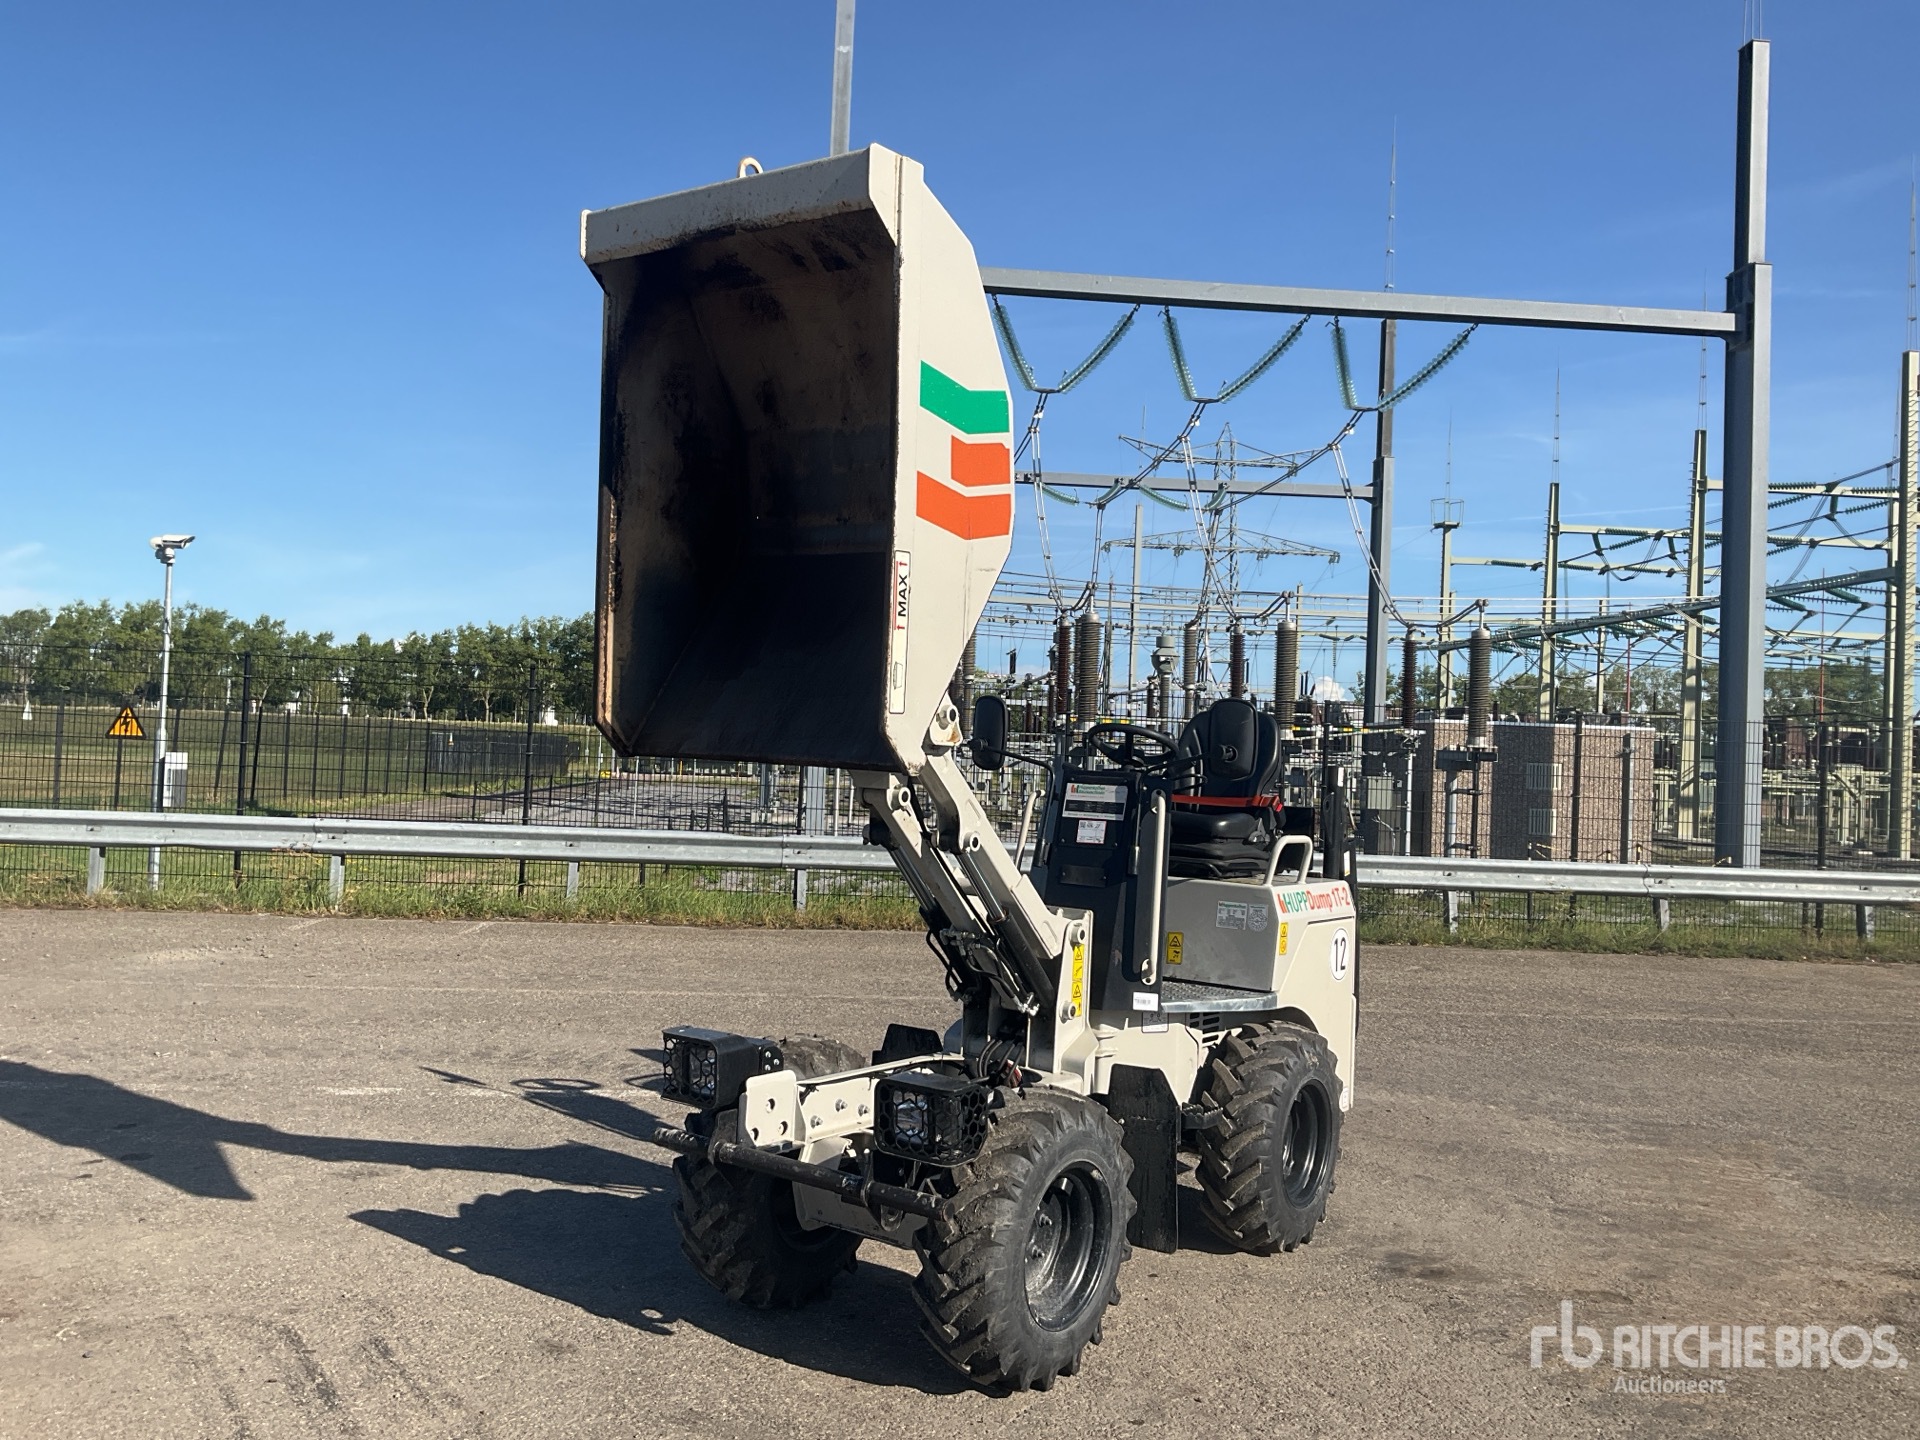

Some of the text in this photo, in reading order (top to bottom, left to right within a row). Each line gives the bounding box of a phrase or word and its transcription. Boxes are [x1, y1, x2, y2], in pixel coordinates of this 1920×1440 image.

[898, 574, 907, 617] MAX
[1331, 886, 1351, 907] 1T-2
[1334, 937, 1347, 972] 12
